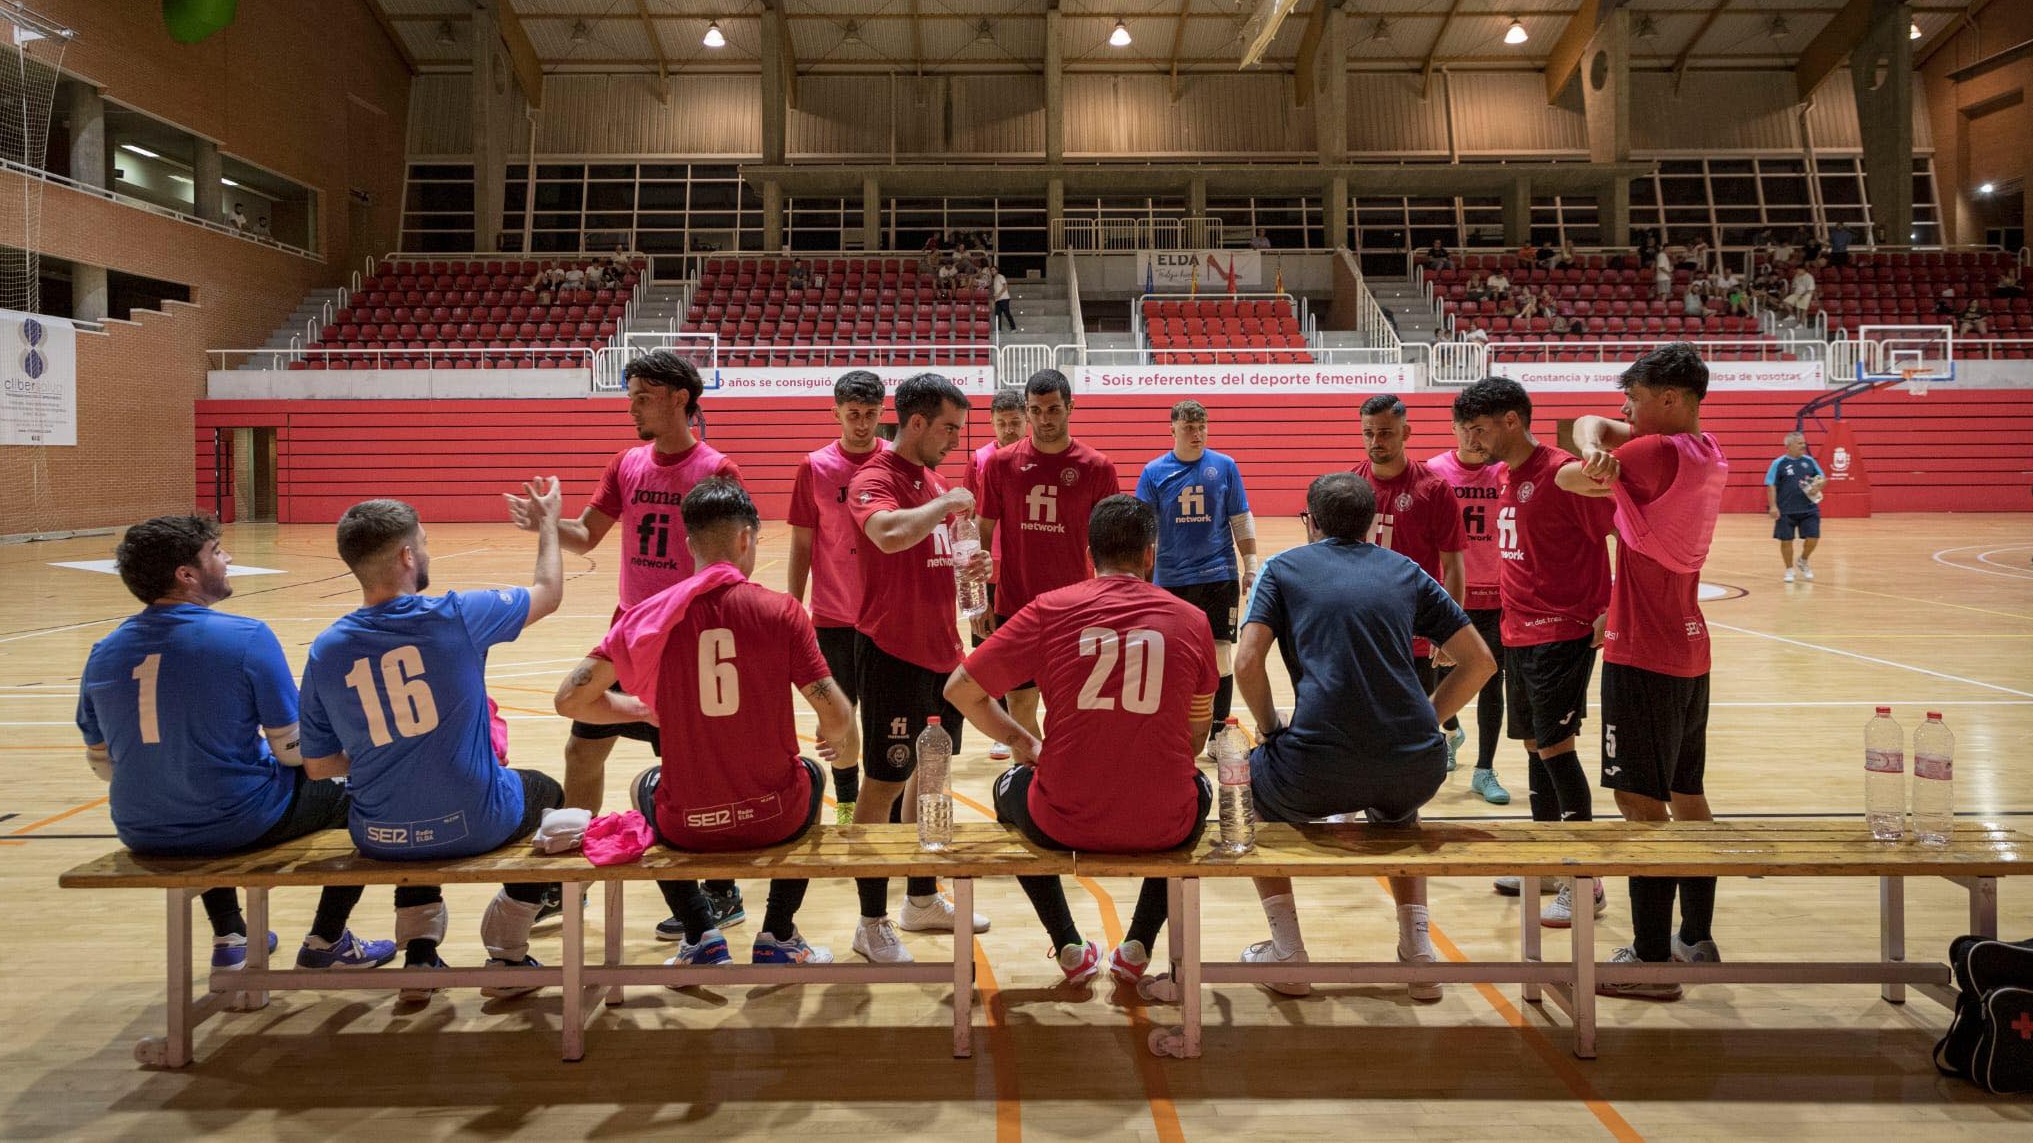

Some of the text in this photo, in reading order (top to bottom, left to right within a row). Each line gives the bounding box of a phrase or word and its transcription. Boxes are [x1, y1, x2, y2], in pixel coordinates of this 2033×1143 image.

[1158, 255, 1200, 266] ELDA
[728, 377, 756, 387] años
[759, 379, 772, 387] se
[1102, 372, 1388, 387] Sois referentes del deporte femenino
[1521, 373, 1581, 382] Constancia
[1584, 374, 1590, 384] y
[1738, 372, 1753, 381] de
[1755, 373, 1802, 381] vosotras
[1025, 484, 1058, 523] fi
[1177, 485, 1205, 515] fi
[1453, 486, 1499, 499] oma
[1020, 522, 1065, 533] network
[1175, 514, 1212, 524] network
[1462, 505, 1485, 534] fi
[1497, 506, 1518, 549] fi
[636, 513, 670, 558] fi
[631, 557, 678, 570] network
[698, 628, 740, 717] 6
[1077, 627, 1166, 715] 20
[132, 653, 162, 744] 1
[344, 645, 440, 748] 16
[1605, 724, 1617, 759] 5
